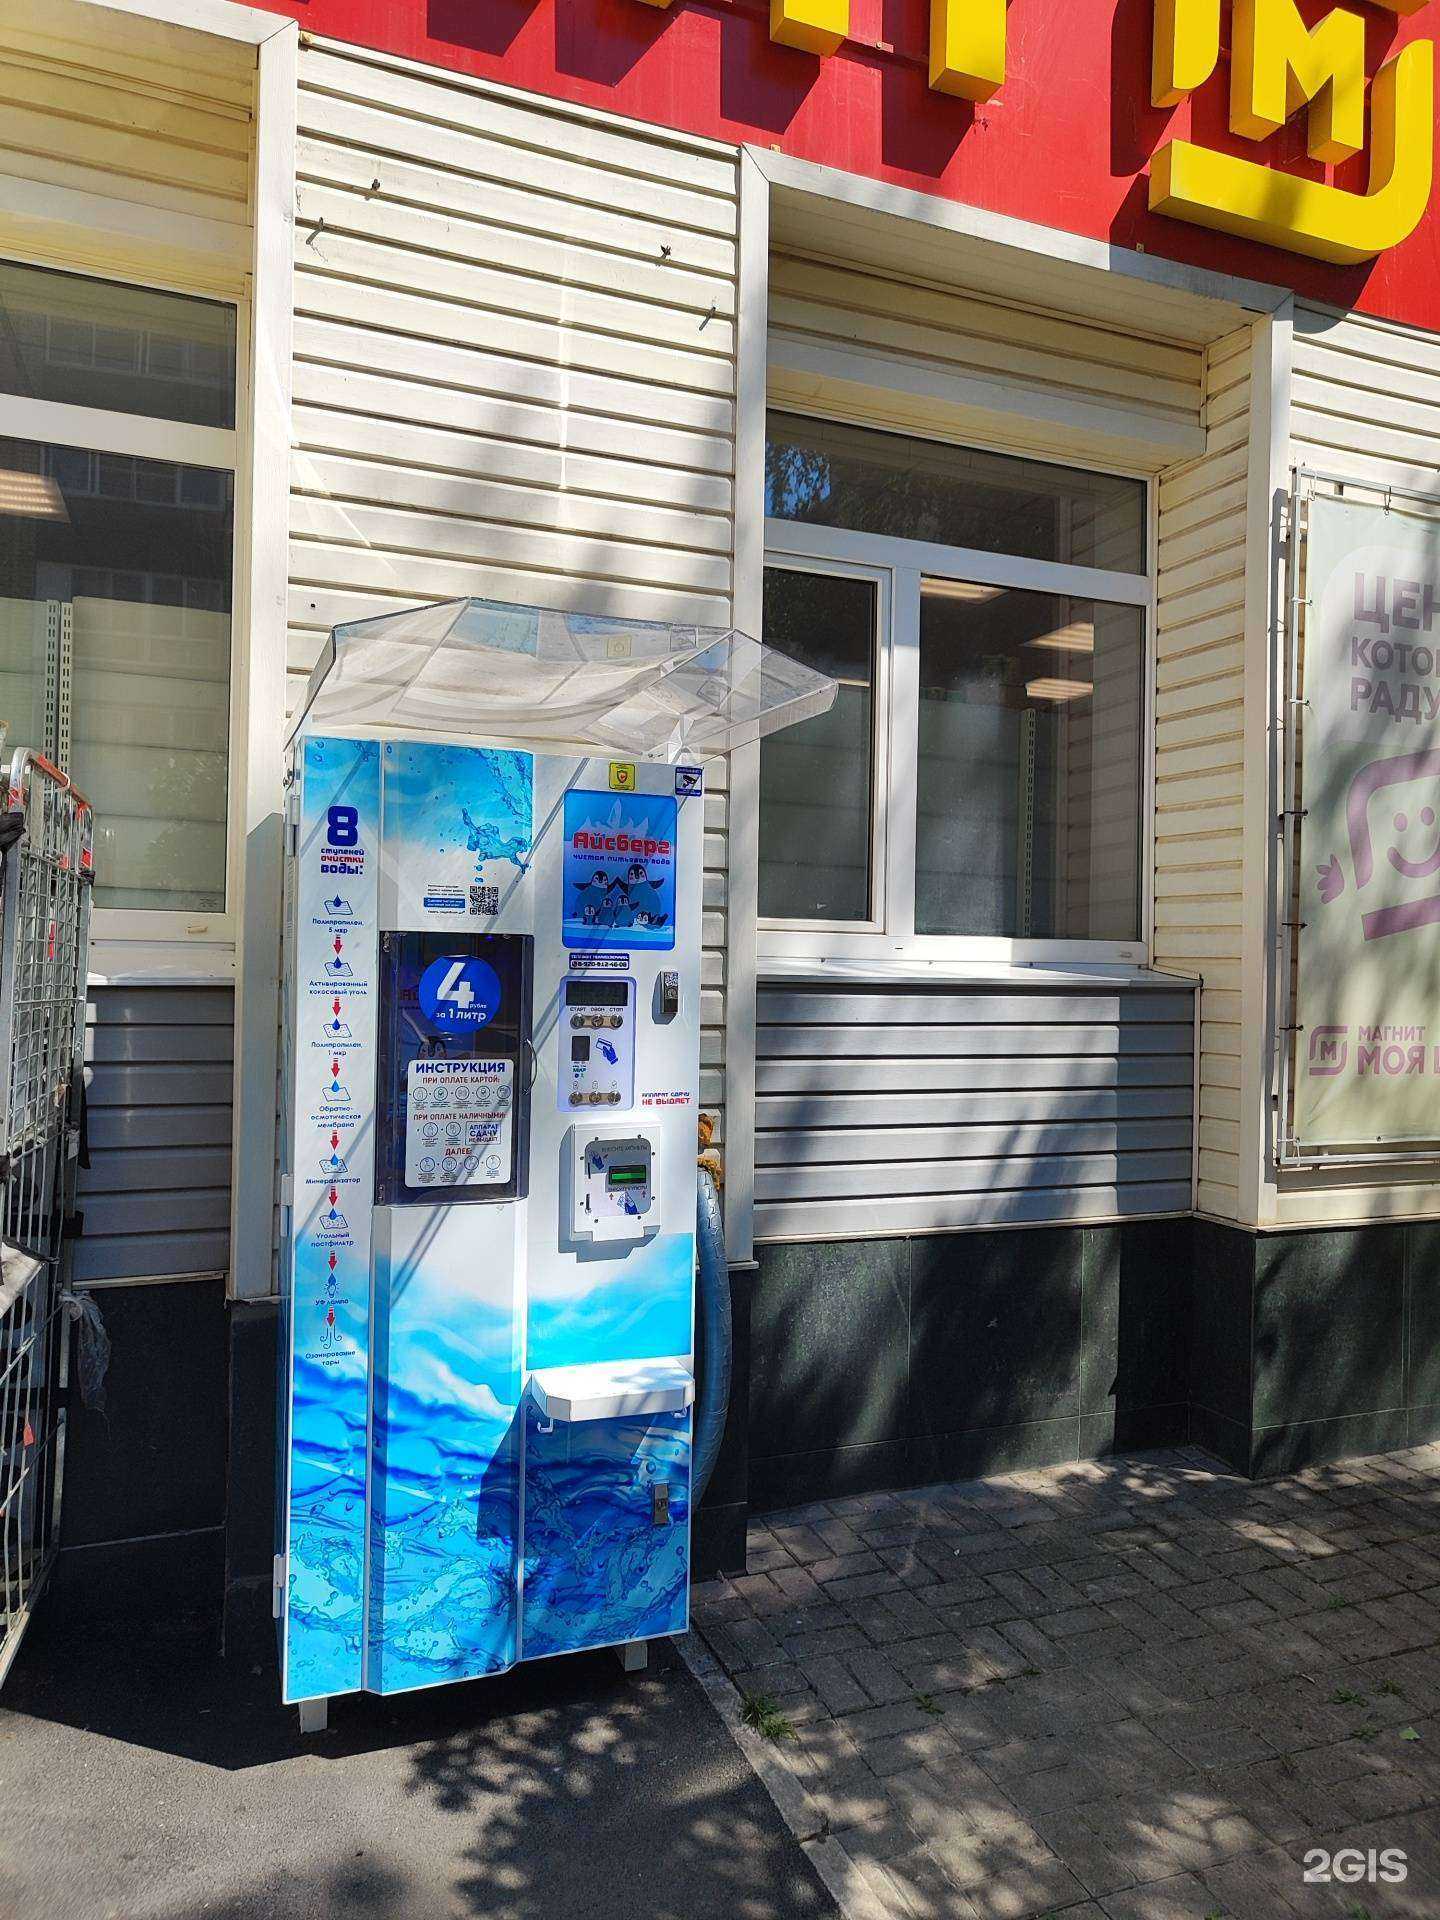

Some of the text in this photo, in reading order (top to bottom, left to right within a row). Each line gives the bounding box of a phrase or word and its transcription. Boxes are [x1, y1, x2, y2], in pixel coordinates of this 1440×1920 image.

[1352, 636, 1440, 677] КОТО
[327, 805, 359, 847] 8
[573, 832, 671, 857] Айсберг
[320, 855, 365, 863] очистки
[320, 863, 364, 875] воды:
[436, 962, 475, 1009] 4
[448, 1008, 454, 1019] 1
[456, 1011, 487, 1023] литр
[1358, 1025, 1426, 1041] МАГНИТ
[1357, 1045, 1425, 1075] МОЯ
[415, 1062, 506, 1074] ИНСТРУКЦИЯ
[440, 1076, 469, 1084] ОПЛАТЕ
[642, 1098, 653, 1106] НЕ
